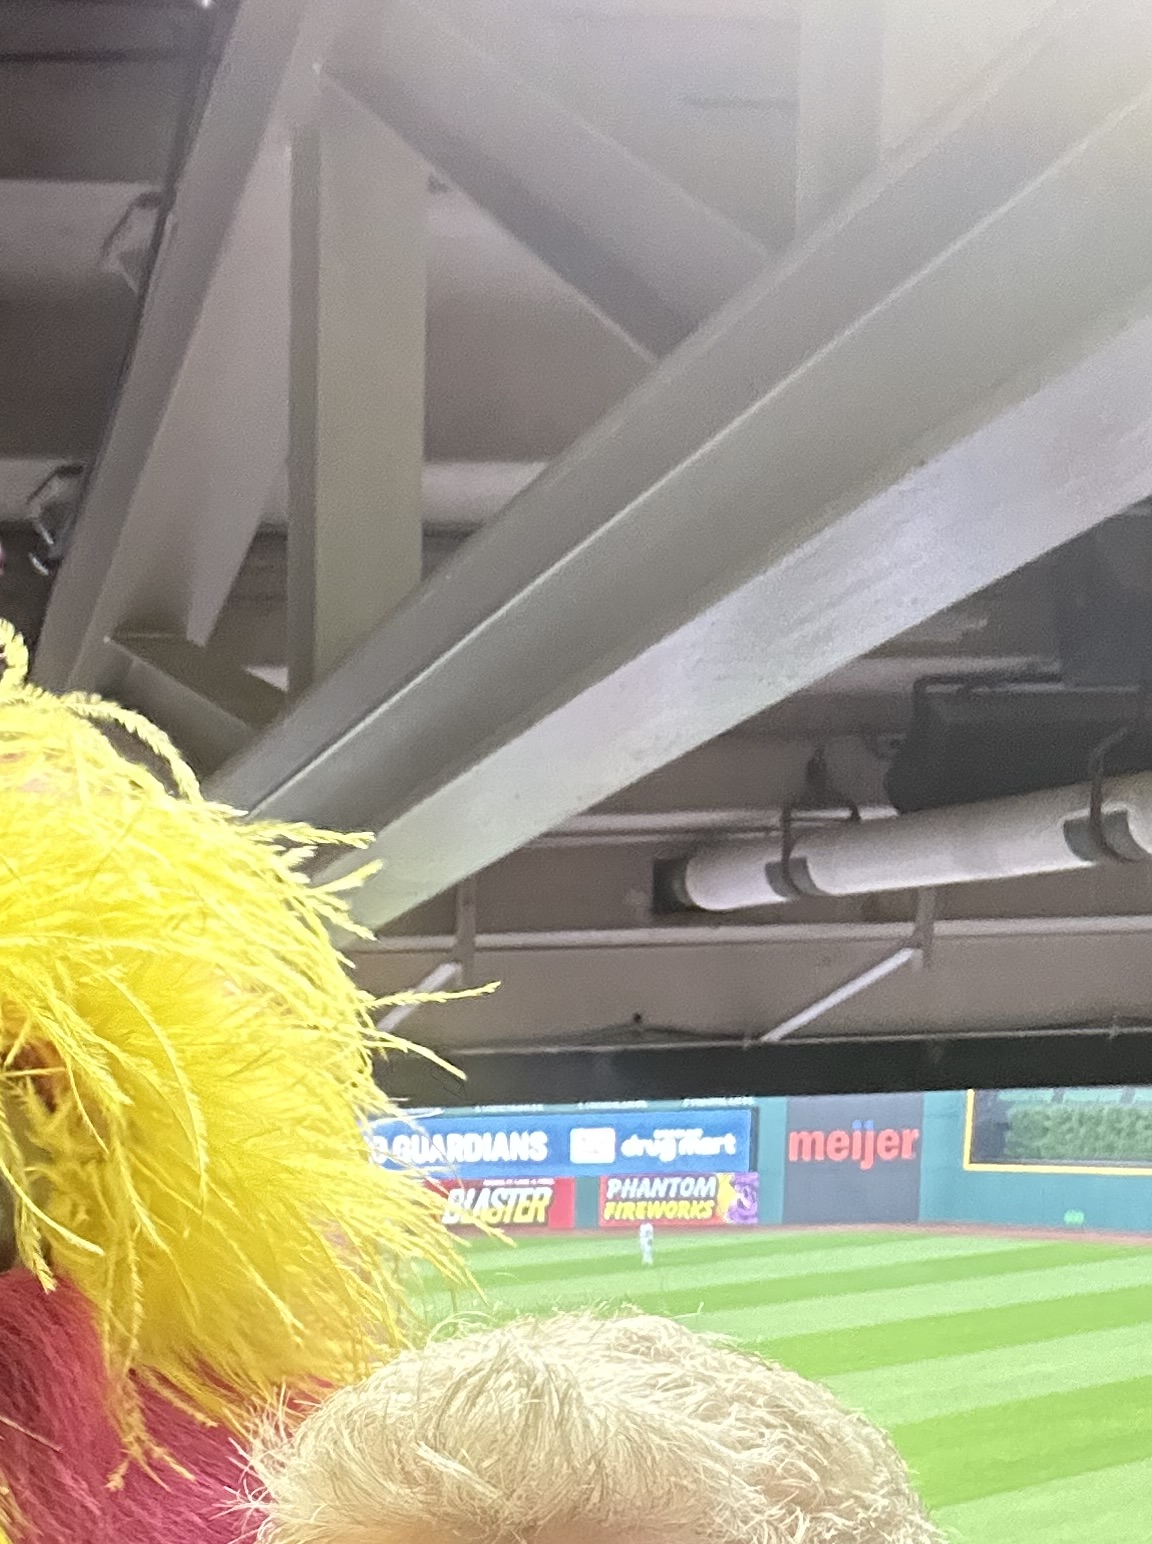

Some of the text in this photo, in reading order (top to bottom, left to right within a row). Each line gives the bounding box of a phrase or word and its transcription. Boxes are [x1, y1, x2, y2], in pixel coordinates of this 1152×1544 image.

[392, 1131, 548, 1164] GUARDIANS
[788, 1119, 920, 1171] meijer
[606, 1176, 717, 1200] PHANTOM
[442, 1186, 553, 1225] BLASTER
[603, 1200, 716, 1221] FIREWORKS
